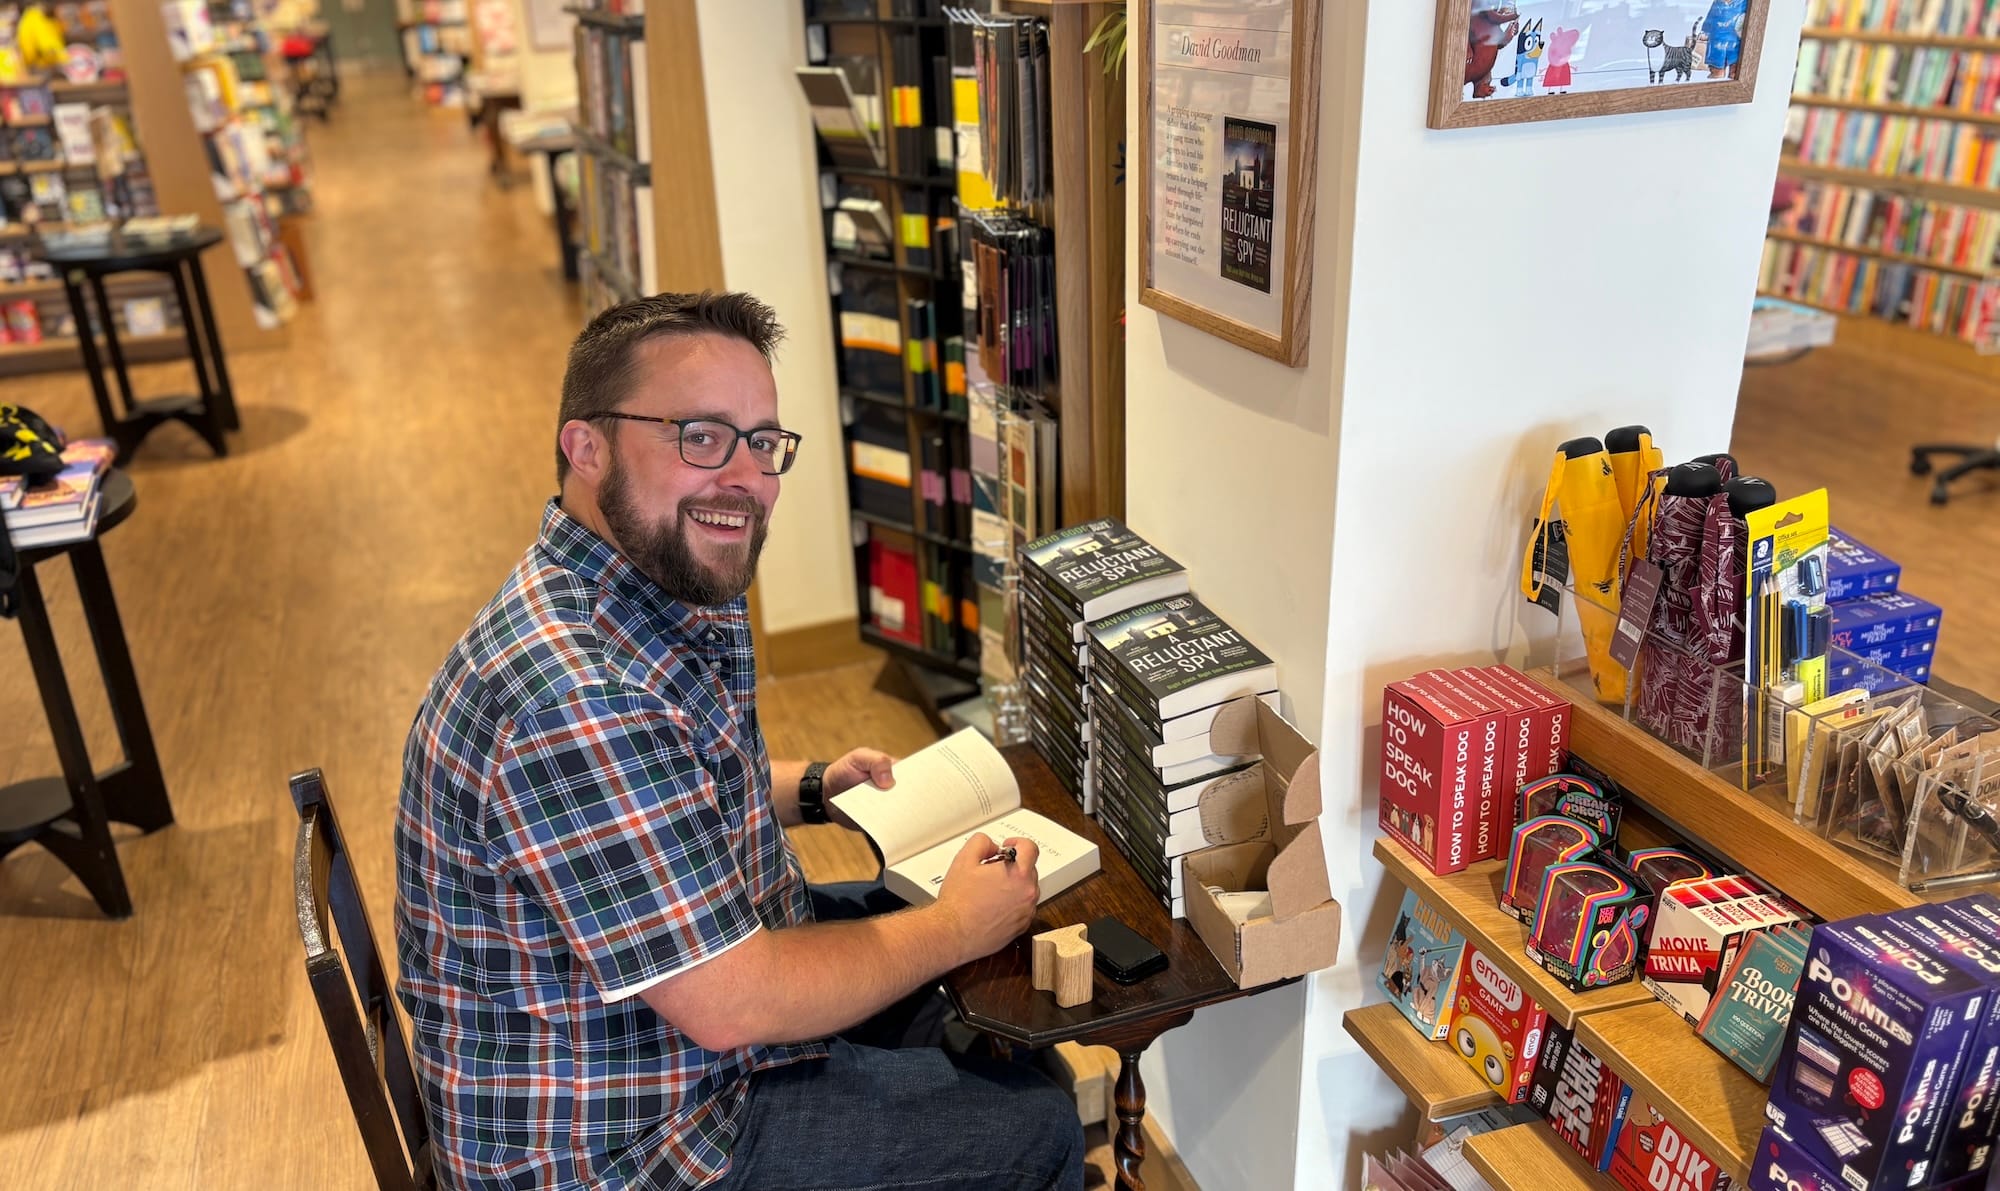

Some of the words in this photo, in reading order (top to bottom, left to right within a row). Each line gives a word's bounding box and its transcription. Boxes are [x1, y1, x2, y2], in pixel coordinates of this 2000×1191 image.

[1181, 35, 1210, 59] David
[1213, 38, 1261, 63] Goodman
[1190, 176, 1208, 192] helping
[1223, 207, 1272, 243] RELUCTANT
[1237, 238, 1255, 265] SPY
[1028, 534, 1060, 551] DAVID
[1094, 551, 1104, 559] A
[1058, 545, 1159, 584] RELUCTANT
[1102, 563, 1140, 581] SPY
[1096, 615, 1130, 630] DAVID
[1873, 623, 1885, 631] THE
[1129, 629, 1241, 674] RELUCTANT
[1168, 634, 1181, 644] A
[1177, 652, 1220, 673] SPY
[1427, 671, 1445, 683] HOW
[1450, 687, 1474, 702] SPEAK
[1472, 700, 1490, 712] DOG
[1460, 669, 1478, 680] HOW
[1485, 685, 1508, 701] SPEAK
[1505, 697, 1523, 709] DOG
[1491, 666, 1510, 677] HOW
[1516, 680, 1541, 695] SPEAK
[1538, 694, 1555, 705] DOG
[1401, 681, 1417, 691] HOW
[1424, 692, 1448, 710] SPEAK
[1444, 708, 1463, 721] DOG
[1387, 700, 1427, 737] HOW
[1387, 720, 1407, 745] TO
[1519, 717, 1531, 748] DOG
[1551, 713, 1562, 742] DOG
[1457, 730, 1469, 761] DOG
[1485, 720, 1497, 752] DOG
[1385, 762, 1417, 796] DOG
[1386, 742, 1433, 789] SPEAK
[1481, 756, 1494, 799] SPEAK
[1516, 750, 1527, 793] SPEAK
[1454, 766, 1467, 809] SPEAK
[1566, 792, 1609, 811] DREAM
[1453, 810, 1464, 830] TO
[1480, 801, 1490, 820] TO
[1570, 802, 1604, 819] DROP
[1450, 837, 1463, 866] HOW
[1478, 826, 1489, 854] HOW
[1414, 897, 1452, 945] CHAOS
[1699, 908, 1723, 927] TRIVIA
[1703, 907, 1730, 926] MOVIE
[1726, 903, 1754, 921] MOVIE
[1660, 937, 1709, 953] MOVIE
[1881, 930, 1911, 949] Game
[1650, 954, 1702, 973] TRIVIA
[1854, 925, 1946, 985] POINTLESS
[1911, 946, 1934, 965] Mini
[1935, 962, 1949, 975] The
[1476, 959, 1517, 1003] emoji
[1546, 963, 1572, 982] DROP
[1878, 977, 1899, 995] players
[1478, 988, 1505, 1017] GAME
[1742, 967, 1796, 1010] BOOK
[1808, 957, 1913, 1047] POINTLESS
[1731, 981, 1792, 1027] TRIVIA
[1740, 1019, 1766, 1041] QUESTIONS
[1818, 991, 1836, 1011] The
[1837, 1005, 1858, 1027] Mini
[1858, 1021, 1889, 1048] Game
[1526, 1032, 1538, 1056] emoji
[1808, 1004, 1831, 1025] Where
[1831, 1020, 1843, 1034] the
[1843, 1029, 1866, 1051] lowest
[1866, 1047, 1890, 1068] scorers
[1808, 1014, 1820, 1026] are
[1820, 1022, 1833, 1036] the
[1833, 1031, 1858, 1054] biggest
[1858, 1050, 1886, 1073] winners
[1934, 1063, 1950, 1091] Game
[1959, 1046, 1999, 1129] POINTLESS
[1897, 1059, 1937, 1144] POINTLESS
[1928, 1088, 1940, 1111] Mini
[1922, 1109, 1935, 1128] The
[1657, 1125, 1711, 1191] DIK
